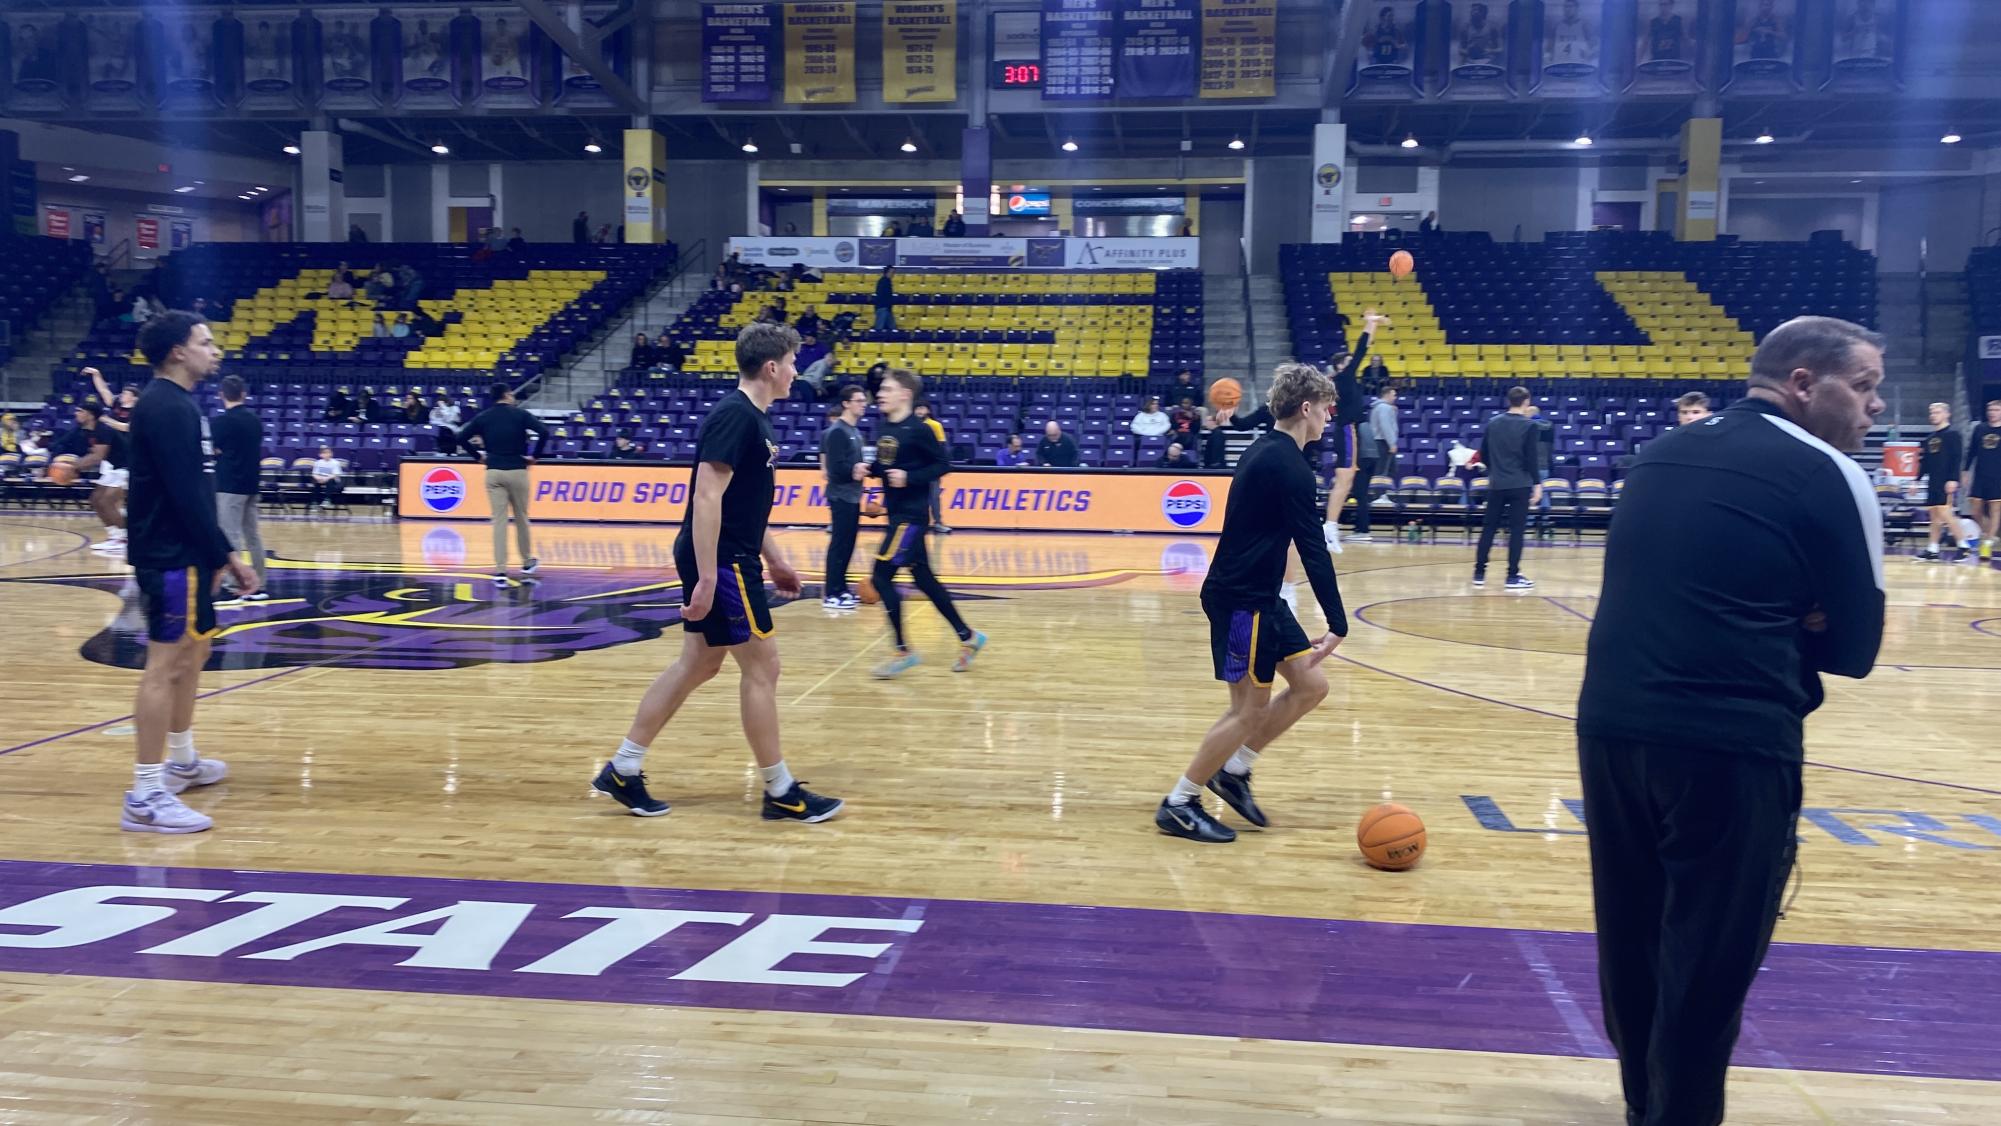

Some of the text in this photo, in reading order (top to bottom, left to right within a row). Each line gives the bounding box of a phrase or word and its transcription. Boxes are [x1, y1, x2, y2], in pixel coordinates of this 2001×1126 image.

[713, 5, 765, 14] WOMEN'S
[895, 5, 944, 13] WOMEN'S
[1046, 11, 1112, 21] BASKETBALL
[1124, 10, 1193, 20] BASKETBALL
[707, 17, 771, 26] BASKETBALL
[788, 16, 851, 25] BASKETBALL
[888, 16, 951, 25] BASKETBALL
[1004, 65, 1039, 83] 3:07
[857, 200, 928, 209] MAVERICK
[1104, 248, 1187, 258] AFFINITY PLUS
[425, 484, 462, 495] PEPSI
[536, 480, 625, 503] PROUD
[773, 485, 801, 507] OF
[949, 488, 1091, 512] ATHLETICS
[1166, 499, 1206, 510] PEPSI
[0, 885, 925, 987] STATE
